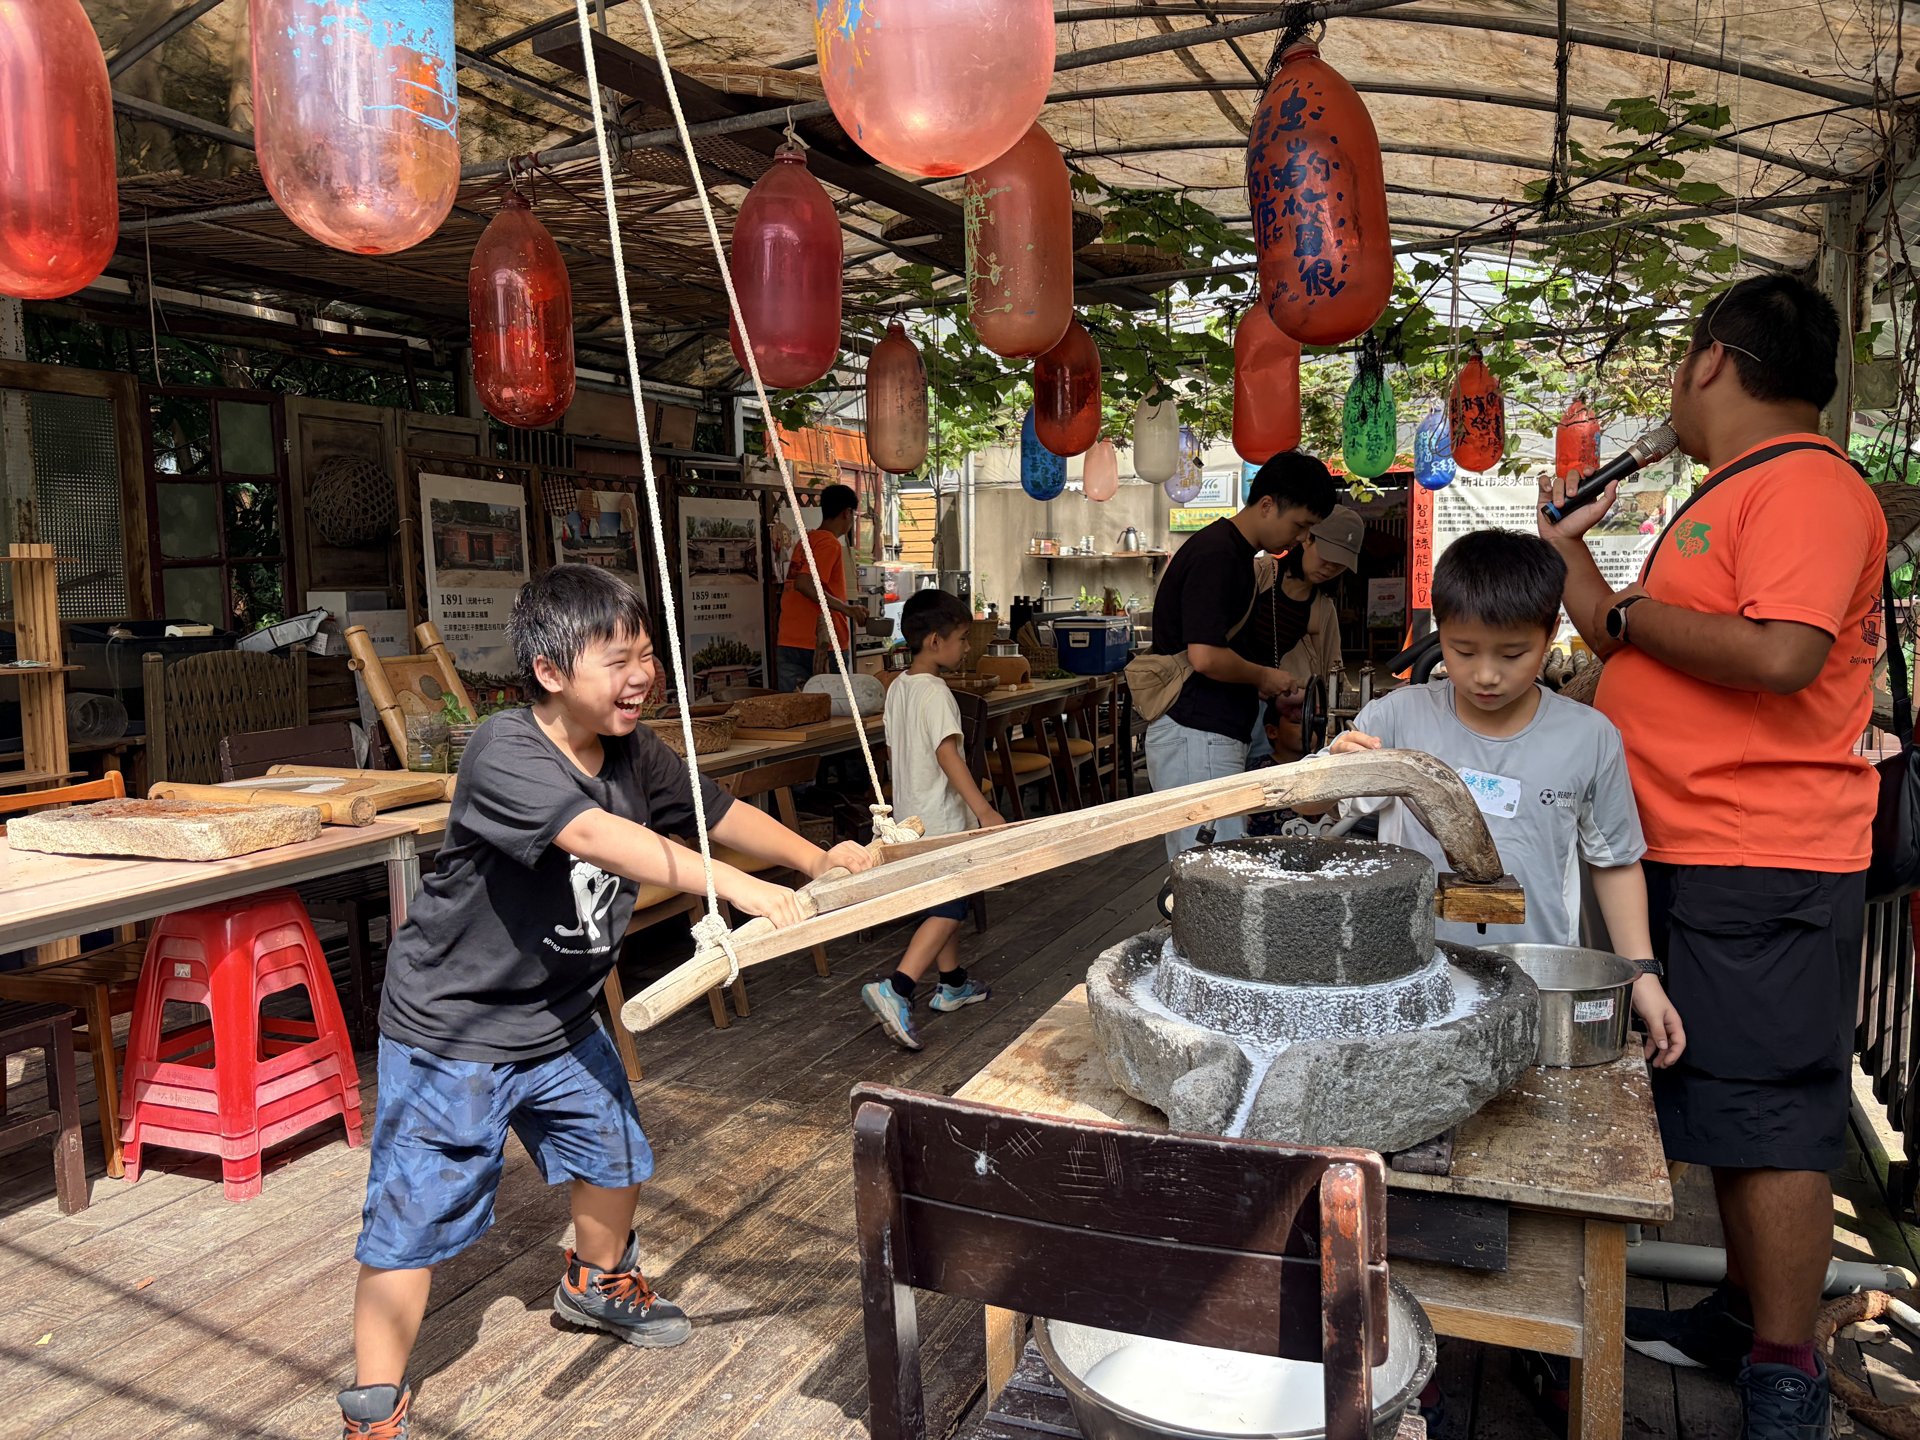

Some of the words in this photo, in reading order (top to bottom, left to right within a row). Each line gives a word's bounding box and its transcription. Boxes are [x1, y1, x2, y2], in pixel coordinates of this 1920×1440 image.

[1461, 476, 1539, 487] 新北市淡水區
[441, 594, 462, 605] 1891
[692, 591, 709, 600] 1859
